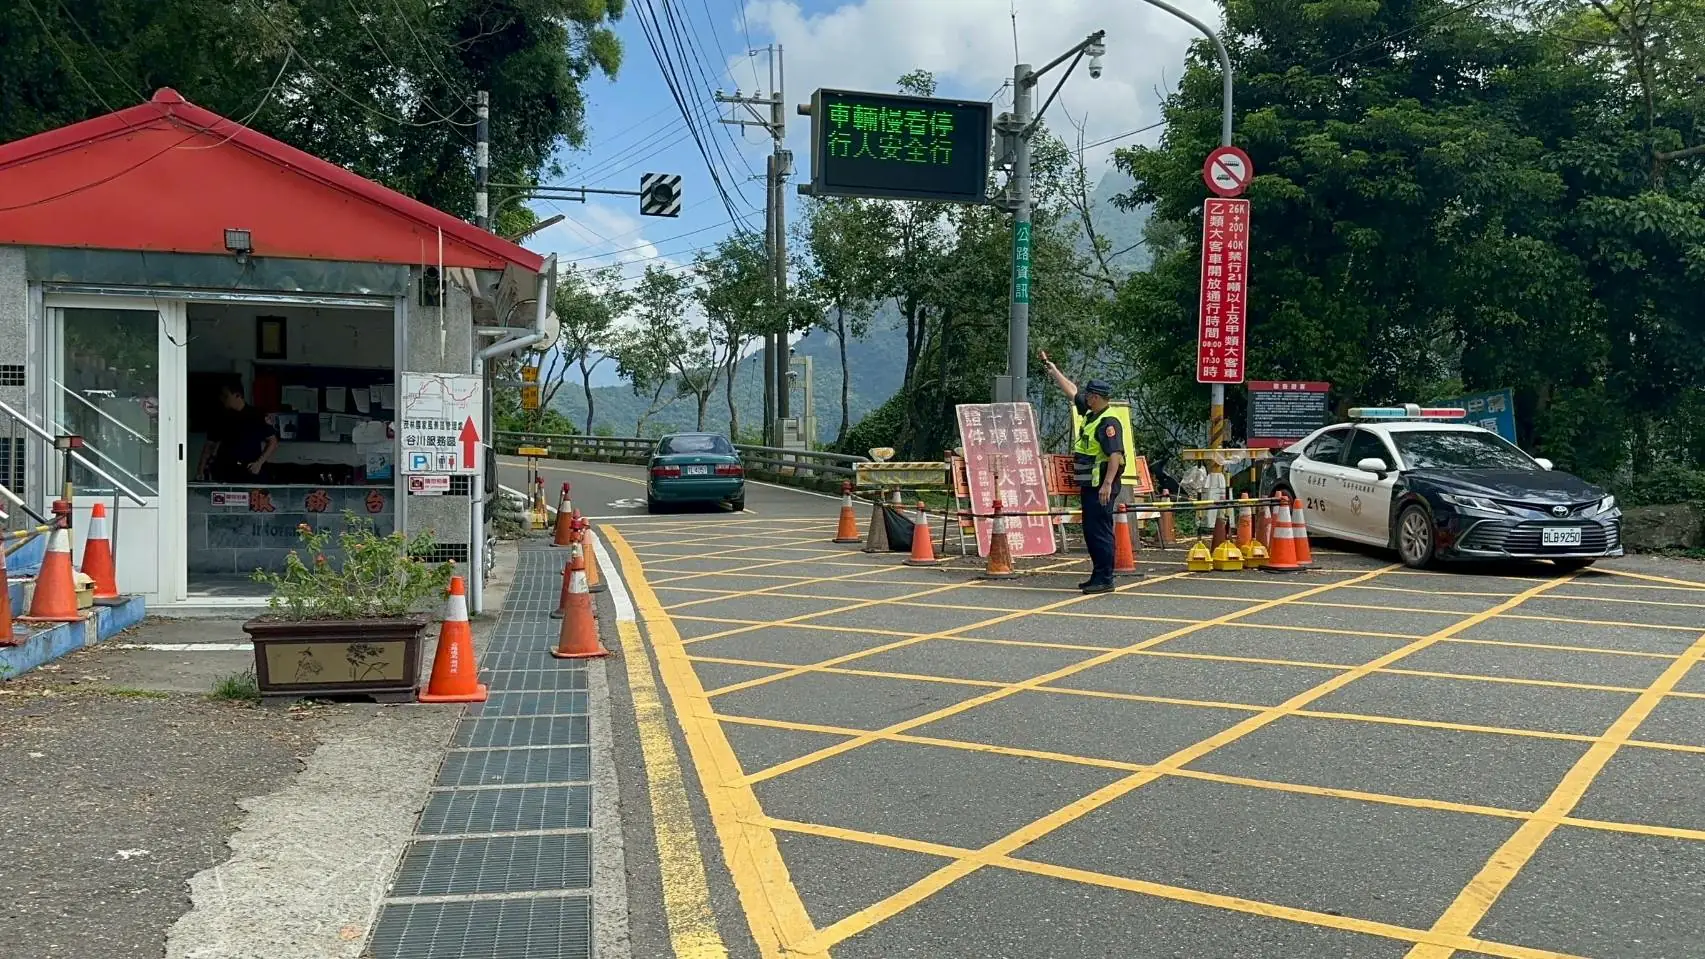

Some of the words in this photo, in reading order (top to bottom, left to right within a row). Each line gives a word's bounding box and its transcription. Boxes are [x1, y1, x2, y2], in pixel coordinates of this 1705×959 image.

[828, 103, 953, 136] 車輛慢看停
[828, 130, 953, 164] 行人安全行
[1015, 226, 1029, 299] 公路資訊
[406, 435, 456, 446] 谷川服務區
[413, 455, 428, 469] P
[1307, 497, 1326, 512] 216
